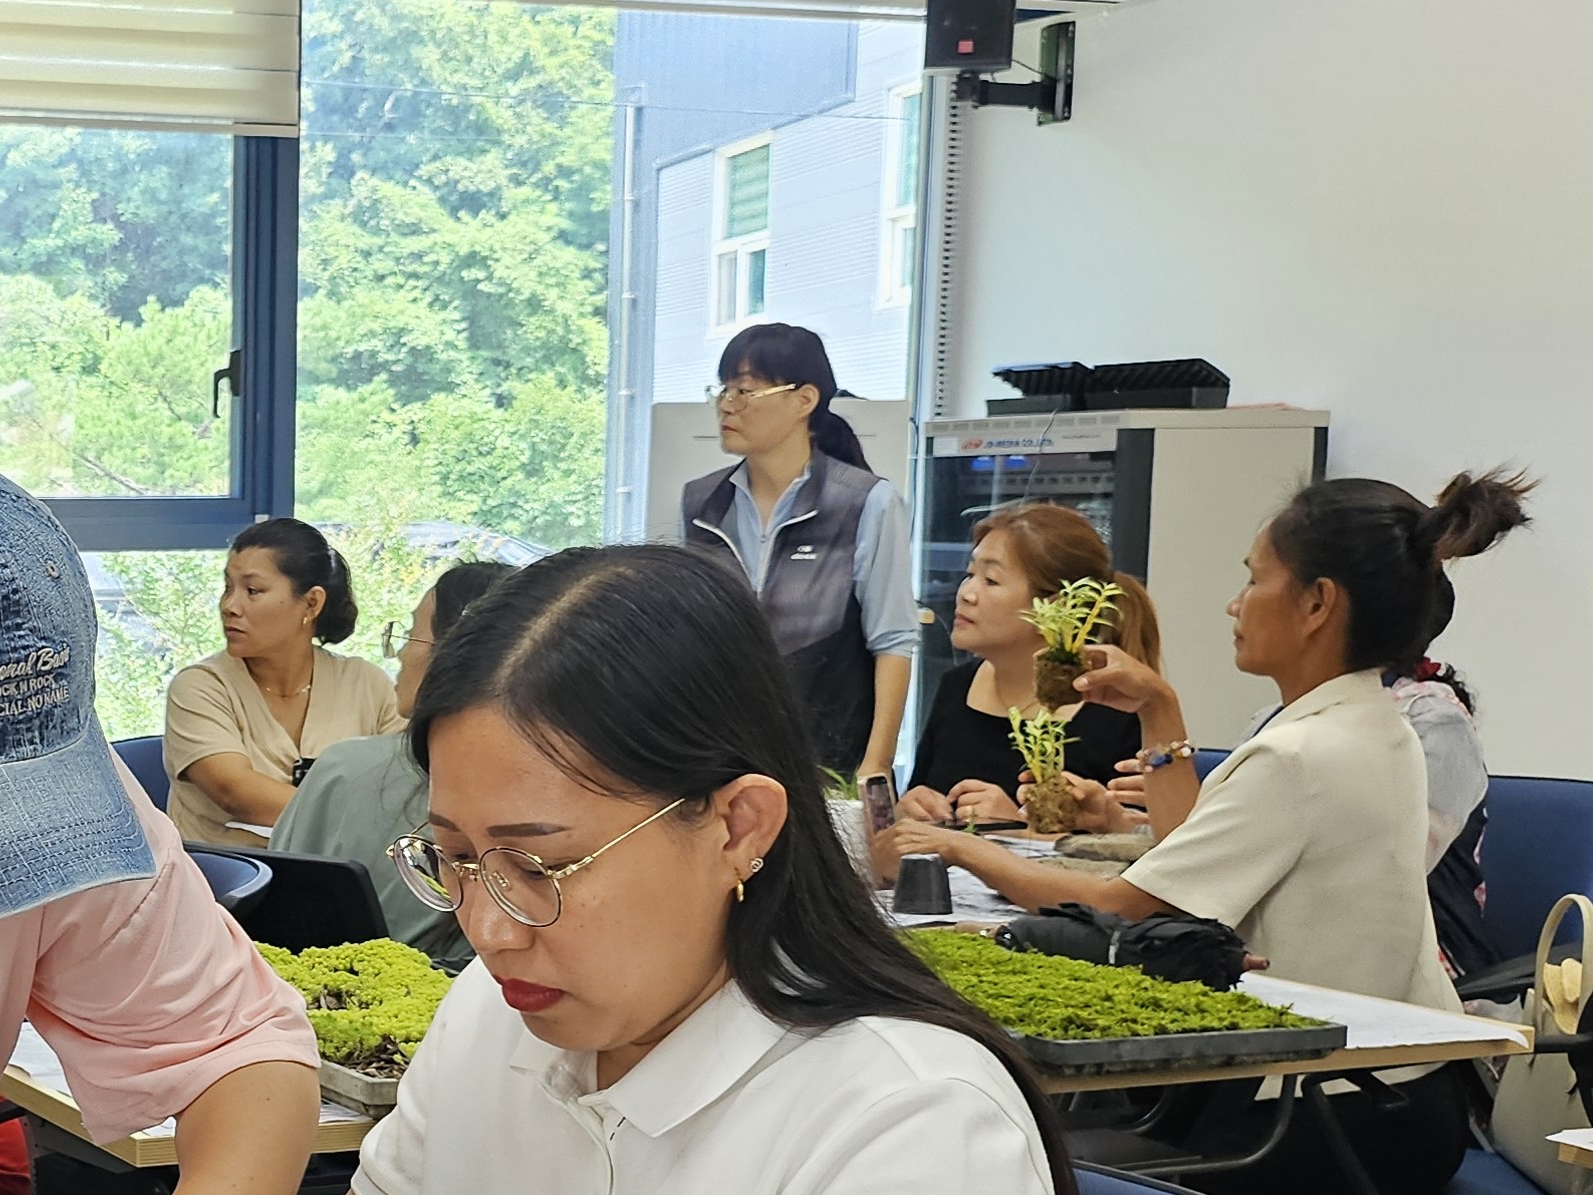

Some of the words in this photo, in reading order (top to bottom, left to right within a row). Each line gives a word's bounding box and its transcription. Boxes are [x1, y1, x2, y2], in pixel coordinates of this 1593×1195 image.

[29, 672, 55, 692] ROCK
[28, 693, 43, 712] NO
[43, 685, 69, 705] NAME
